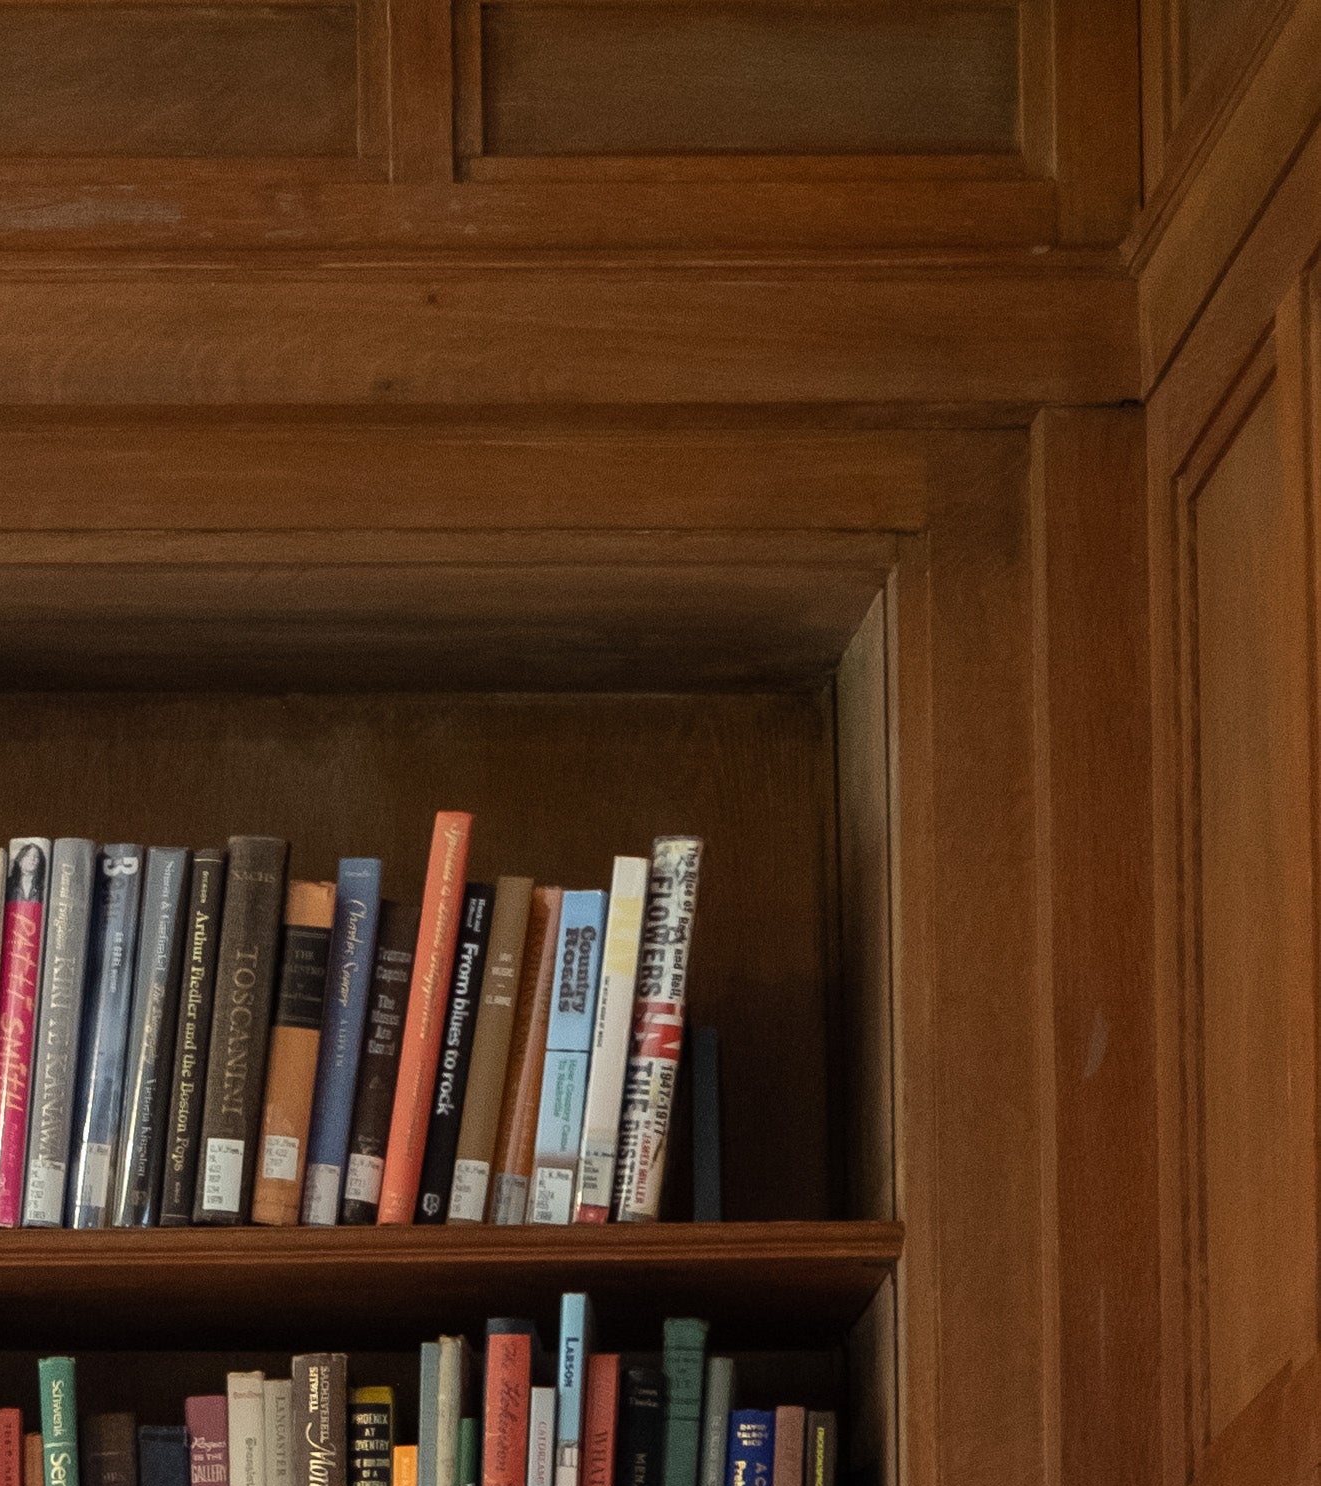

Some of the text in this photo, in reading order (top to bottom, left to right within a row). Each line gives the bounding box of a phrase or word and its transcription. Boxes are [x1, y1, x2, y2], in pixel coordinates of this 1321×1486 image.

[436, 942, 479, 1117] From blues to rock
